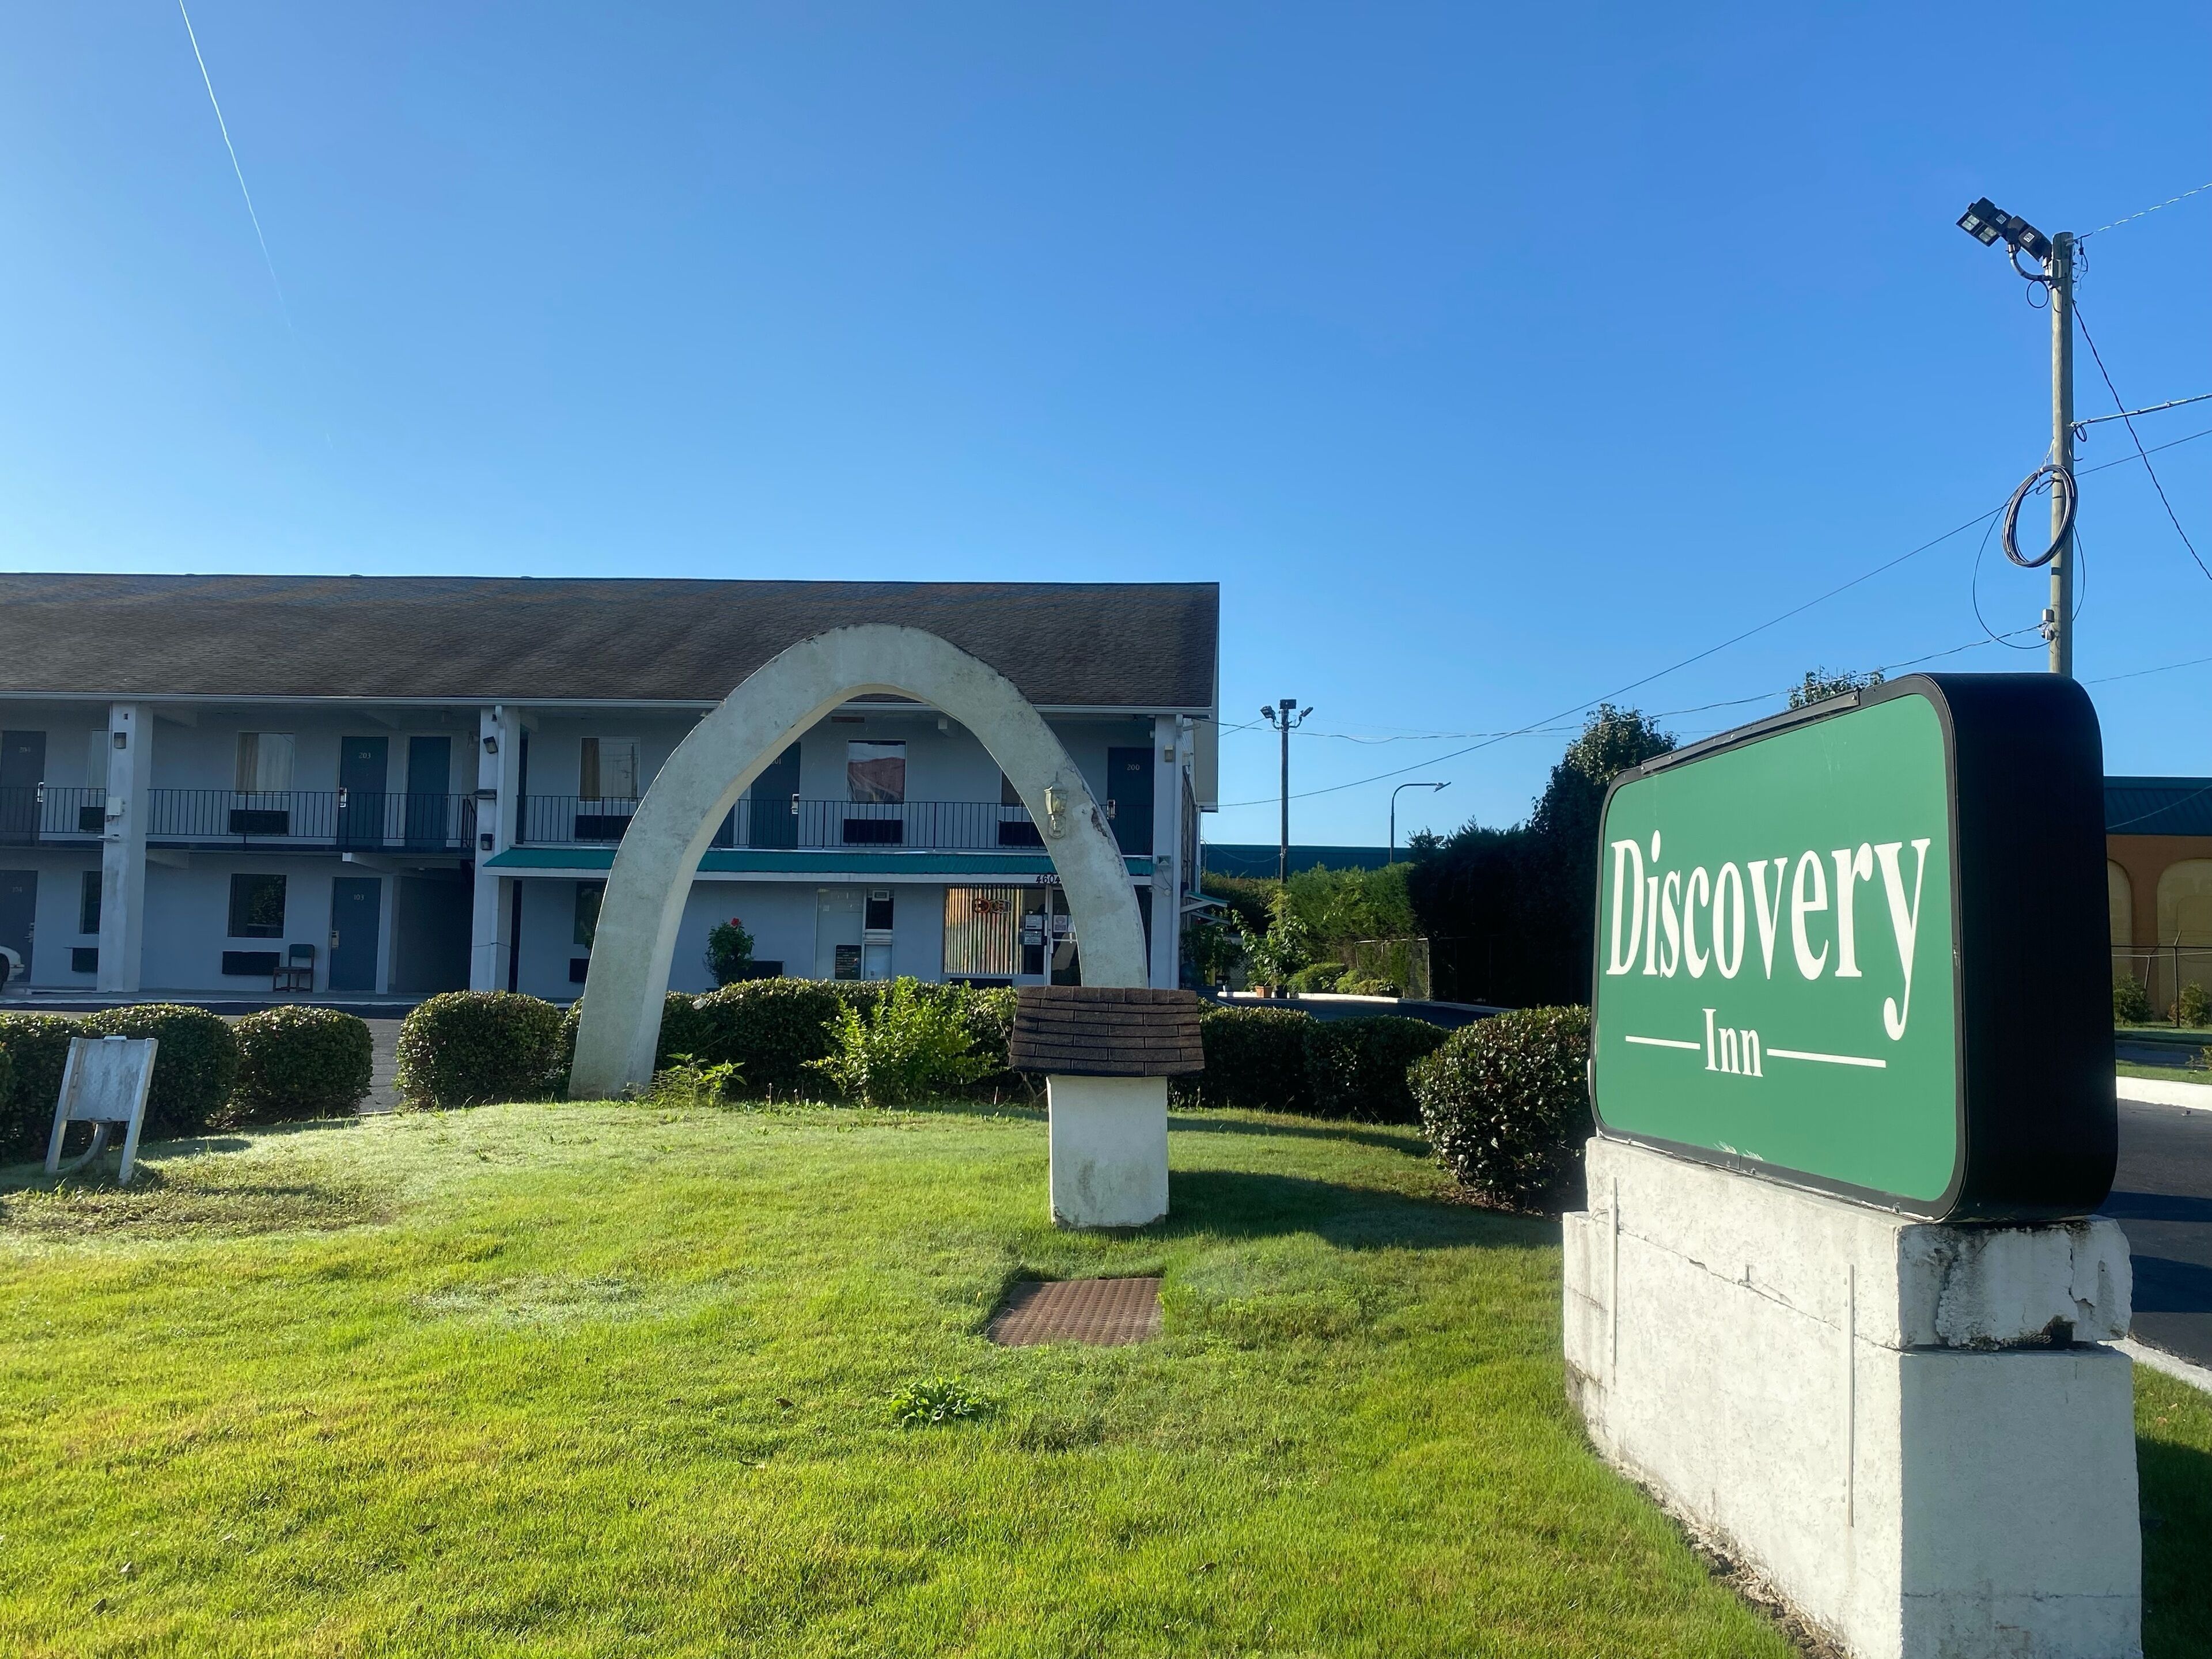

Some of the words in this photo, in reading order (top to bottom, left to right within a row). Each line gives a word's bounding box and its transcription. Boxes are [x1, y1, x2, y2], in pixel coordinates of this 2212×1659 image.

[1036, 874, 1061, 884] 4604
[1605, 830, 1931, 1041] Discovery
[1702, 1007, 1764, 1078] Inn
